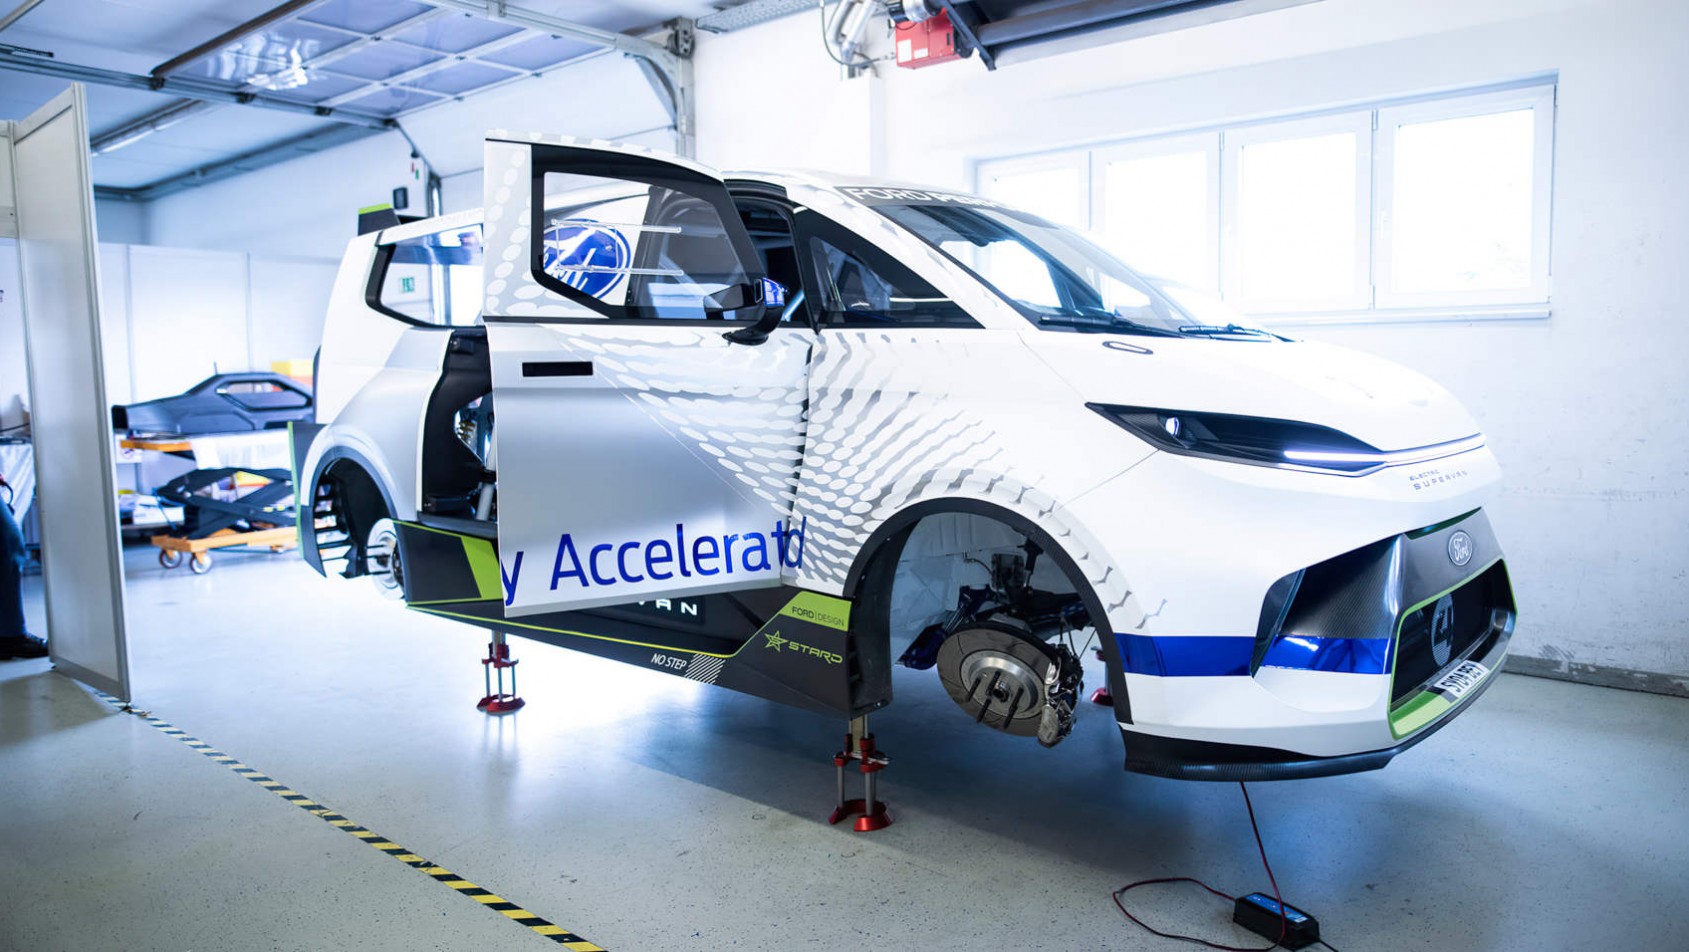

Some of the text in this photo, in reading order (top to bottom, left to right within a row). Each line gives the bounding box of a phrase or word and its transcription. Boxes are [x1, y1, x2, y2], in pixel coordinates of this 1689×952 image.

[844, 187, 932, 201] FORD
[1413, 470, 1468, 490] SUPERVAN
[650, 652, 688, 671] NO STEP
[788, 640, 844, 665] STARD
